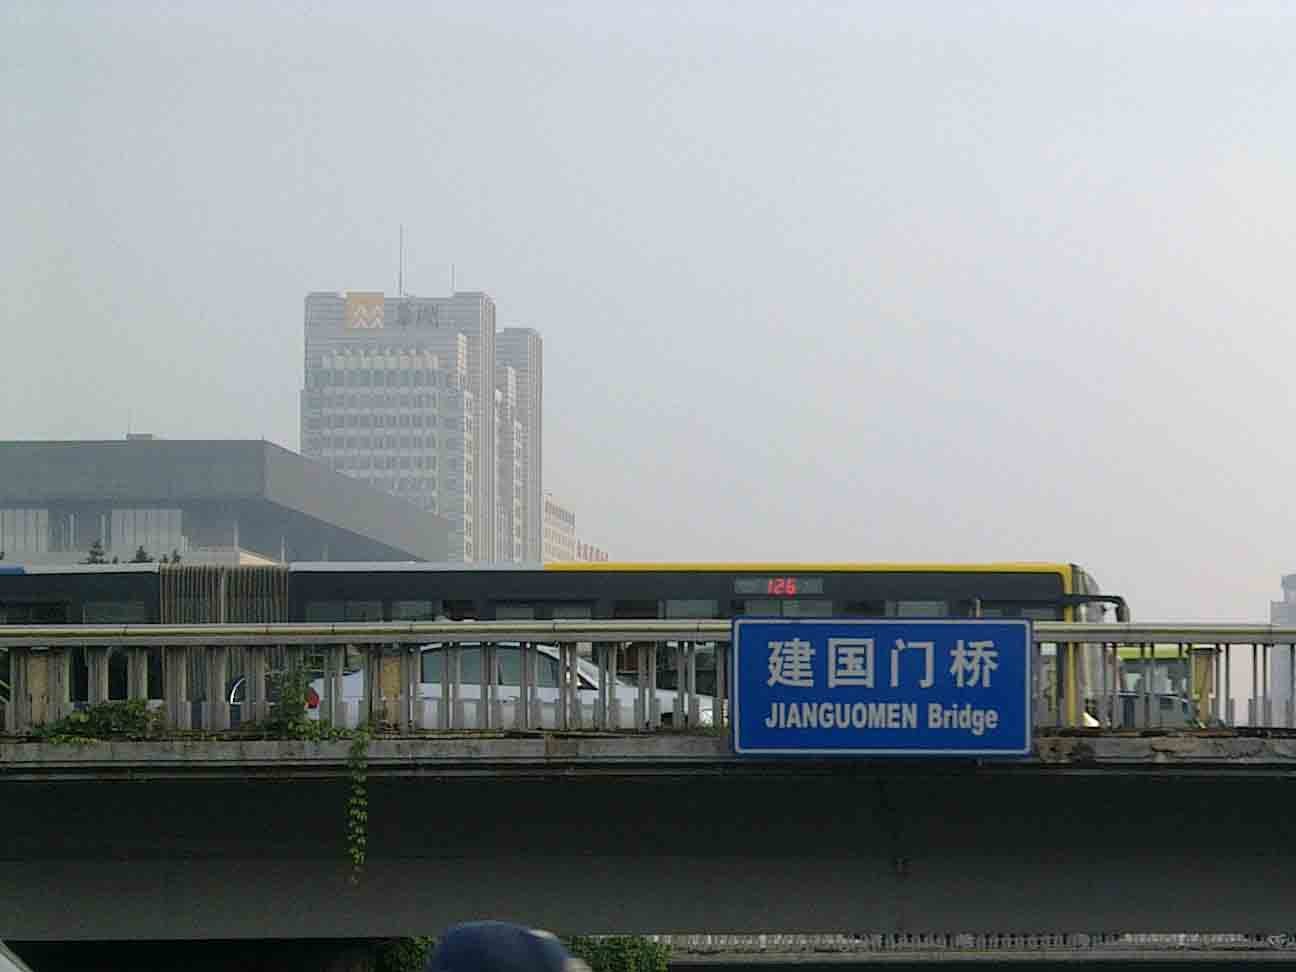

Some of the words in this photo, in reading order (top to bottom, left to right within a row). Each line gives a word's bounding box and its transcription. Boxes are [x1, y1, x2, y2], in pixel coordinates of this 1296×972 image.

[767, 577, 796, 595] 126
[767, 638, 998, 688] 建国门桥
[766, 702, 917, 729] JIANGUOMEN
[929, 702, 998, 735] Bridge
